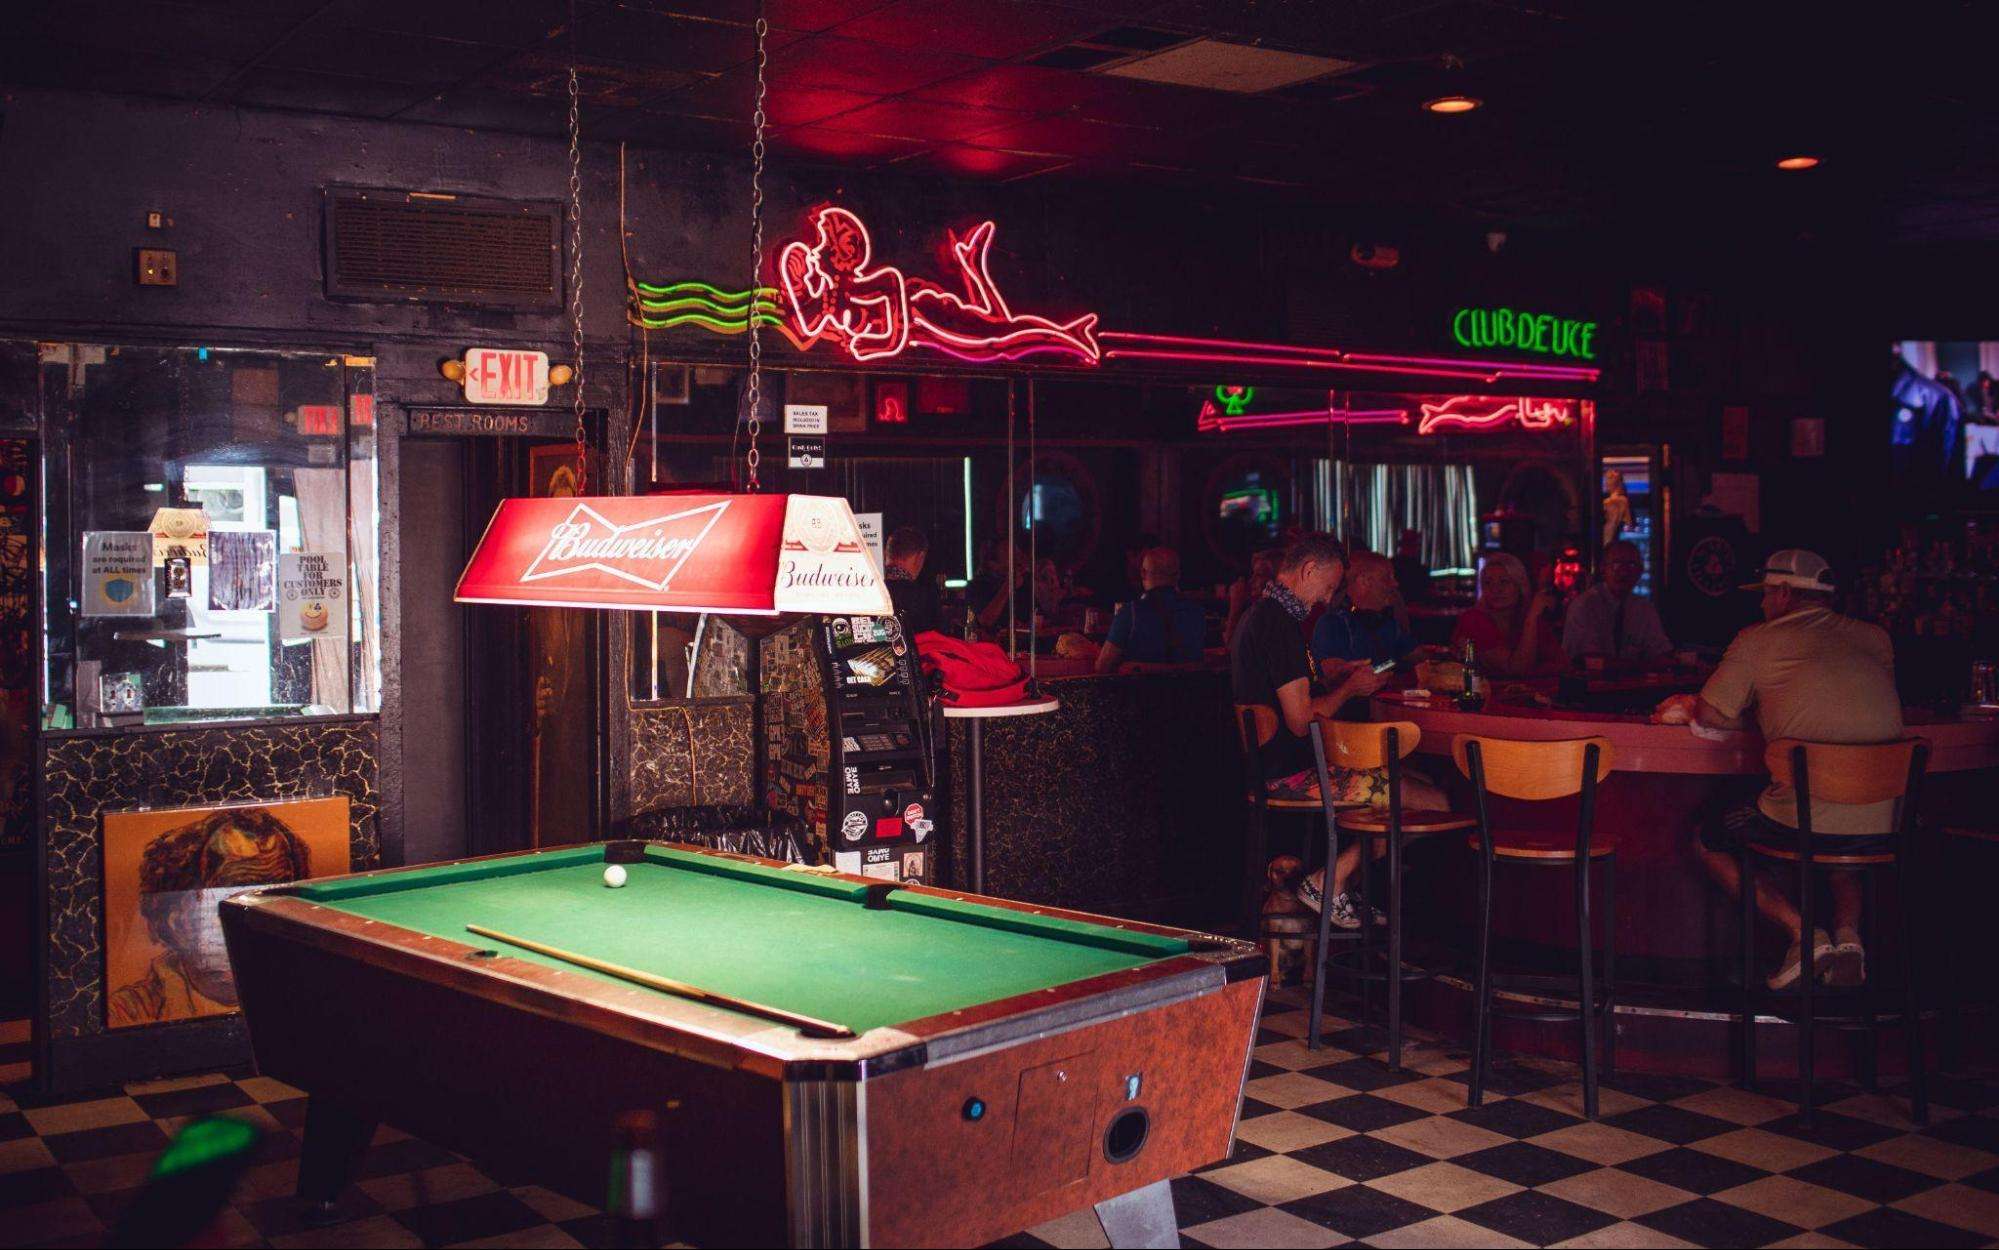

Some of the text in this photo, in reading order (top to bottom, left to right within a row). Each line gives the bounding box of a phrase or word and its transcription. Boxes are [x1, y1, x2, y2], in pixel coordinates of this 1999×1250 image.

[480, 351, 539, 401] EXIT
[419, 412, 529, 433] REST ROOMS
[858, 521, 871, 530] sks
[548, 521, 697, 561] Budweiser
[101, 542, 138, 552] Masks
[299, 555, 326, 564] POOL
[103, 566, 119, 574] ALL
[122, 566, 146, 574] times
[297, 563, 329, 572] TABLE
[303, 571, 323, 580] FOR
[783, 560, 875, 588] Budweiser
[284, 579, 343, 589] CUSTOMERS
[301, 587, 325, 596] ONLY
